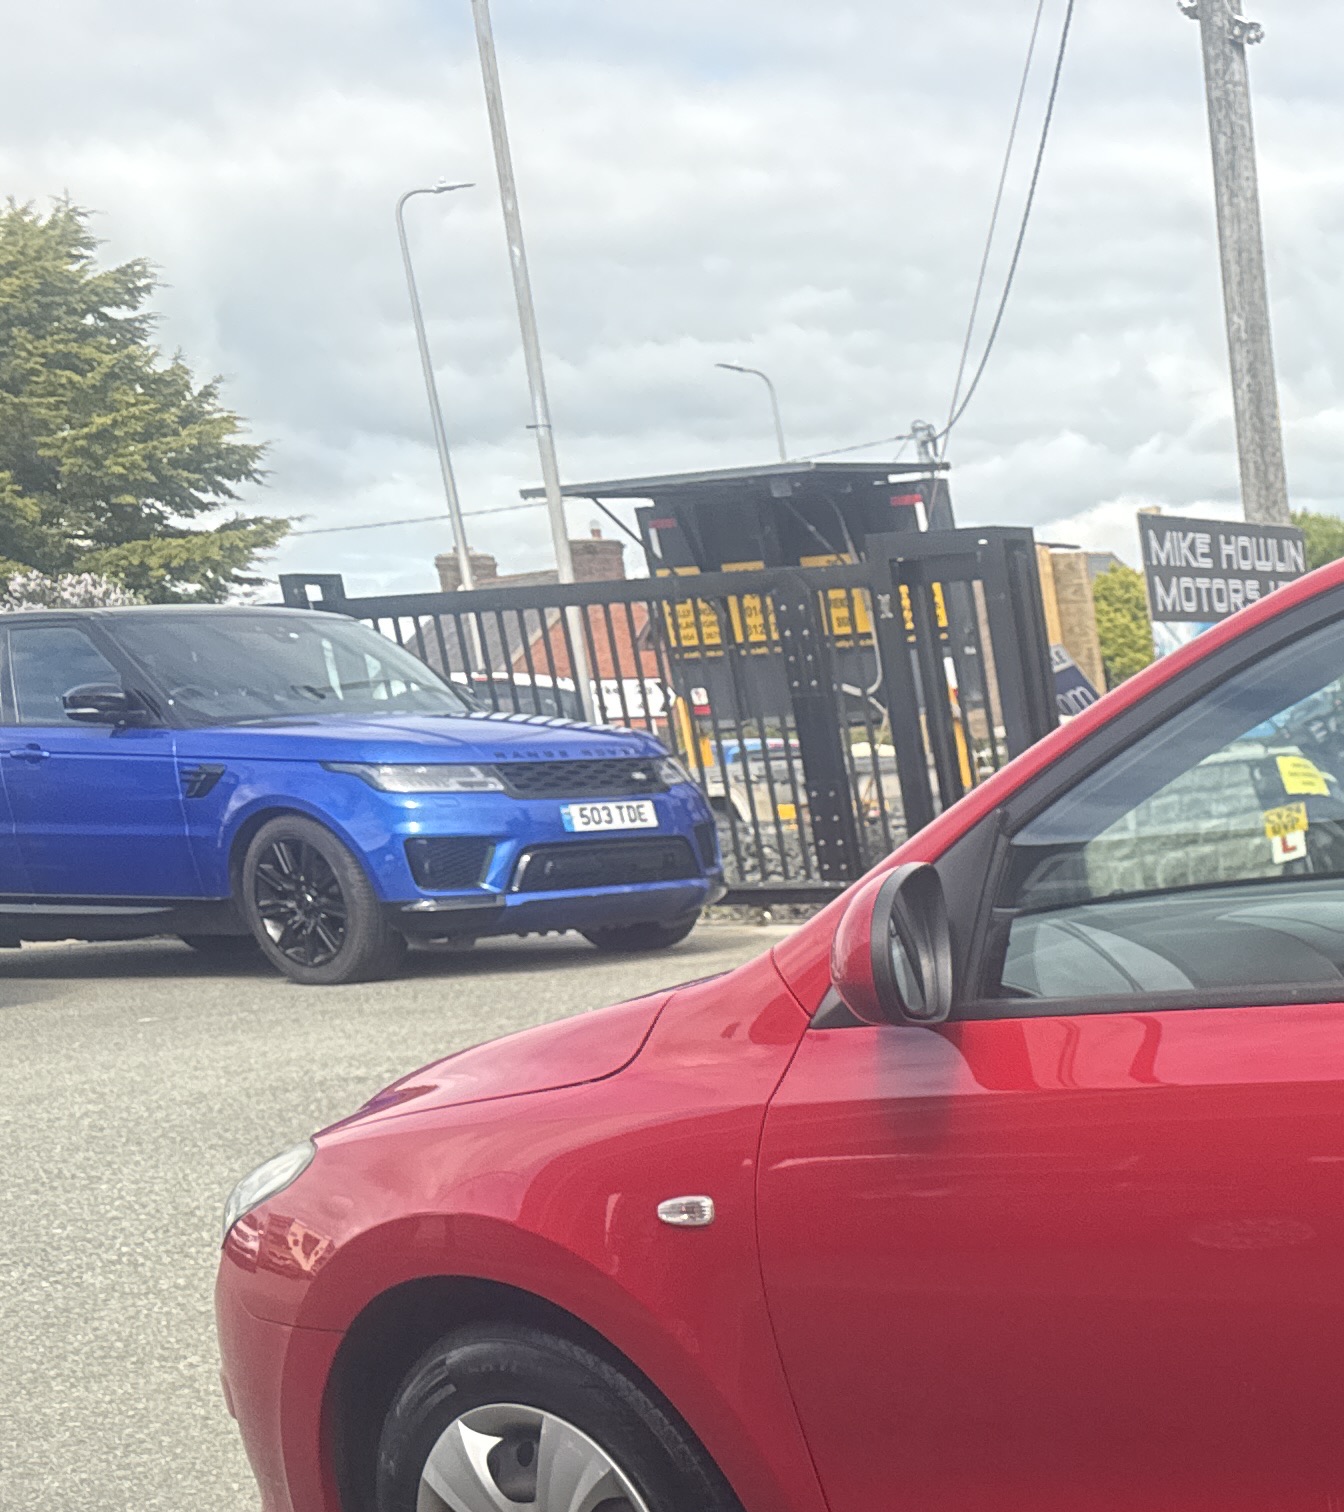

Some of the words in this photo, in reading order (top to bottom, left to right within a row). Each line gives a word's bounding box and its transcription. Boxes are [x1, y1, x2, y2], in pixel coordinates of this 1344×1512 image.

[1148, 529, 1214, 569] MIKE
[1219, 534, 1306, 574] HOWLIN
[1154, 575, 1261, 613] MOTORS
[579, 805, 614, 826] 503
[615, 803, 649, 824] TDE
[1280, 835, 1298, 855] L
